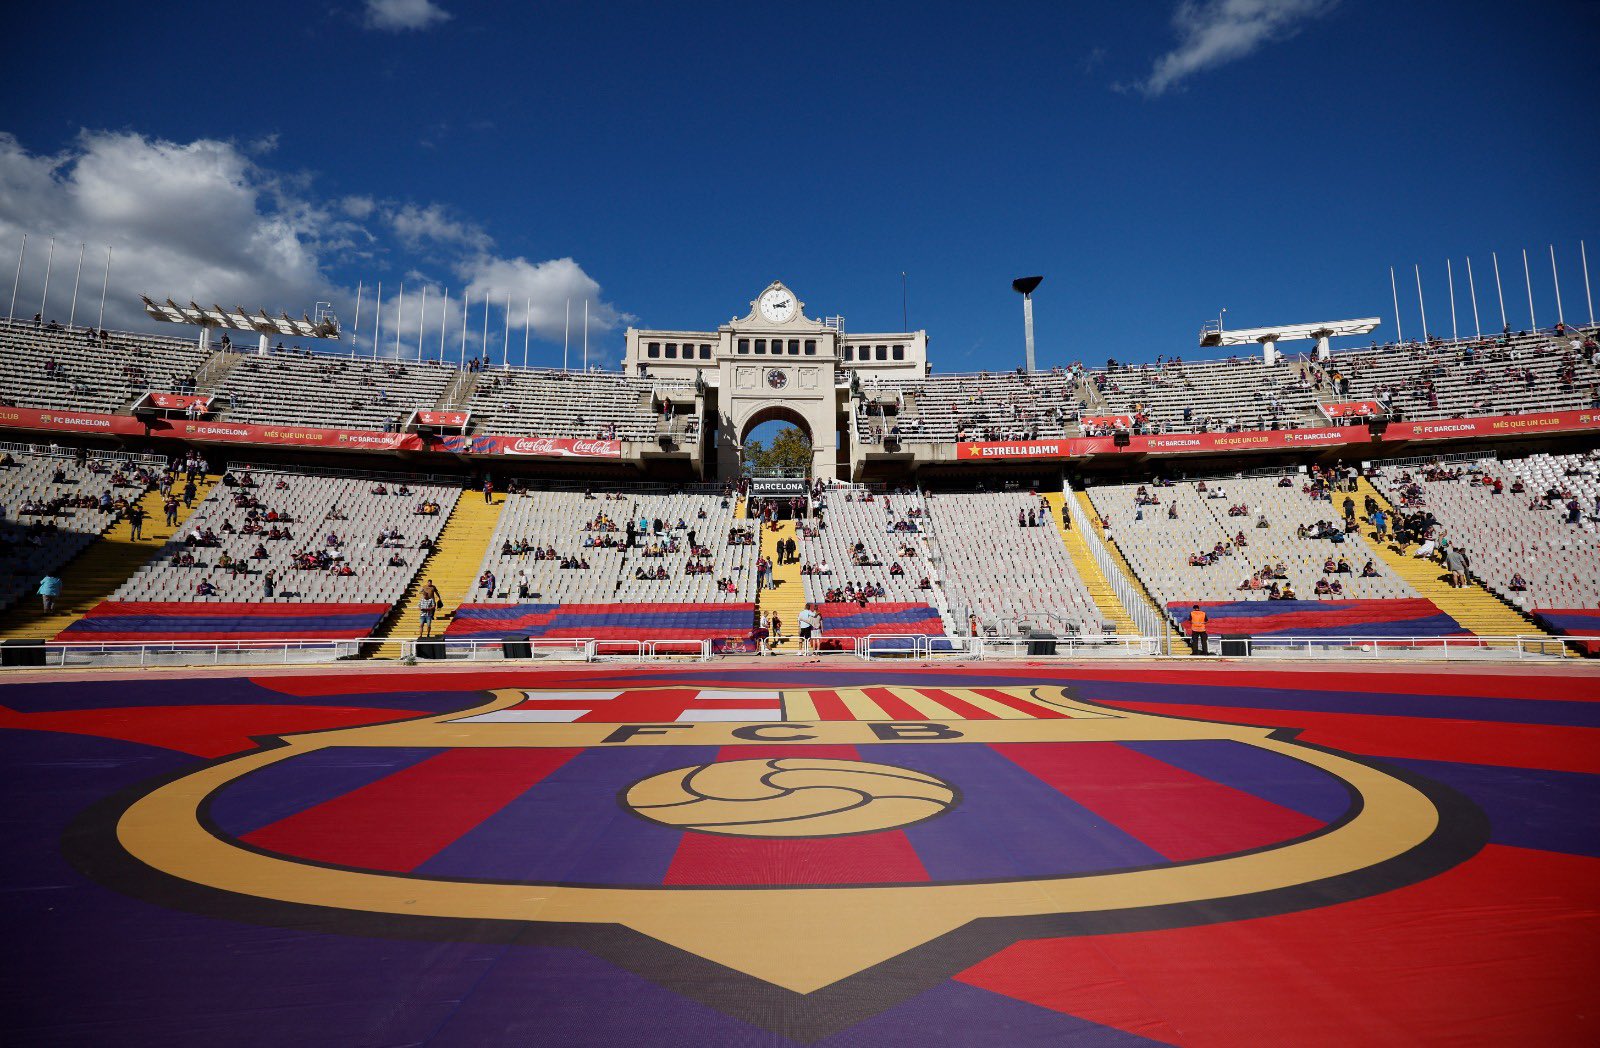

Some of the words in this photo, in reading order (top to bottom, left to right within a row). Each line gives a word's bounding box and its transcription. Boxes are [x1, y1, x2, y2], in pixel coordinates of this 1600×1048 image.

[53, 416, 64, 424] FC
[65, 417, 110, 427] BARCELONA
[1493, 420, 1509, 429] MÉS
[1510, 420, 1525, 428] QUE
[1540, 417, 1560, 425] CLUB
[207, 427, 248, 436] BARCELONA
[1433, 424, 1475, 432] BARCELONA
[264, 430, 279, 438] MÉS
[1303, 432, 1341, 440] BARCELONA
[358, 436, 394, 444] BARCELONA
[1242, 436, 1252, 444] UN
[514, 438, 553, 452] Coca-Cola
[573, 440, 611, 454] Coca-Cola
[982, 446, 1028, 456] ESTRELLA
[1030, 445, 1059, 455] DAMM
